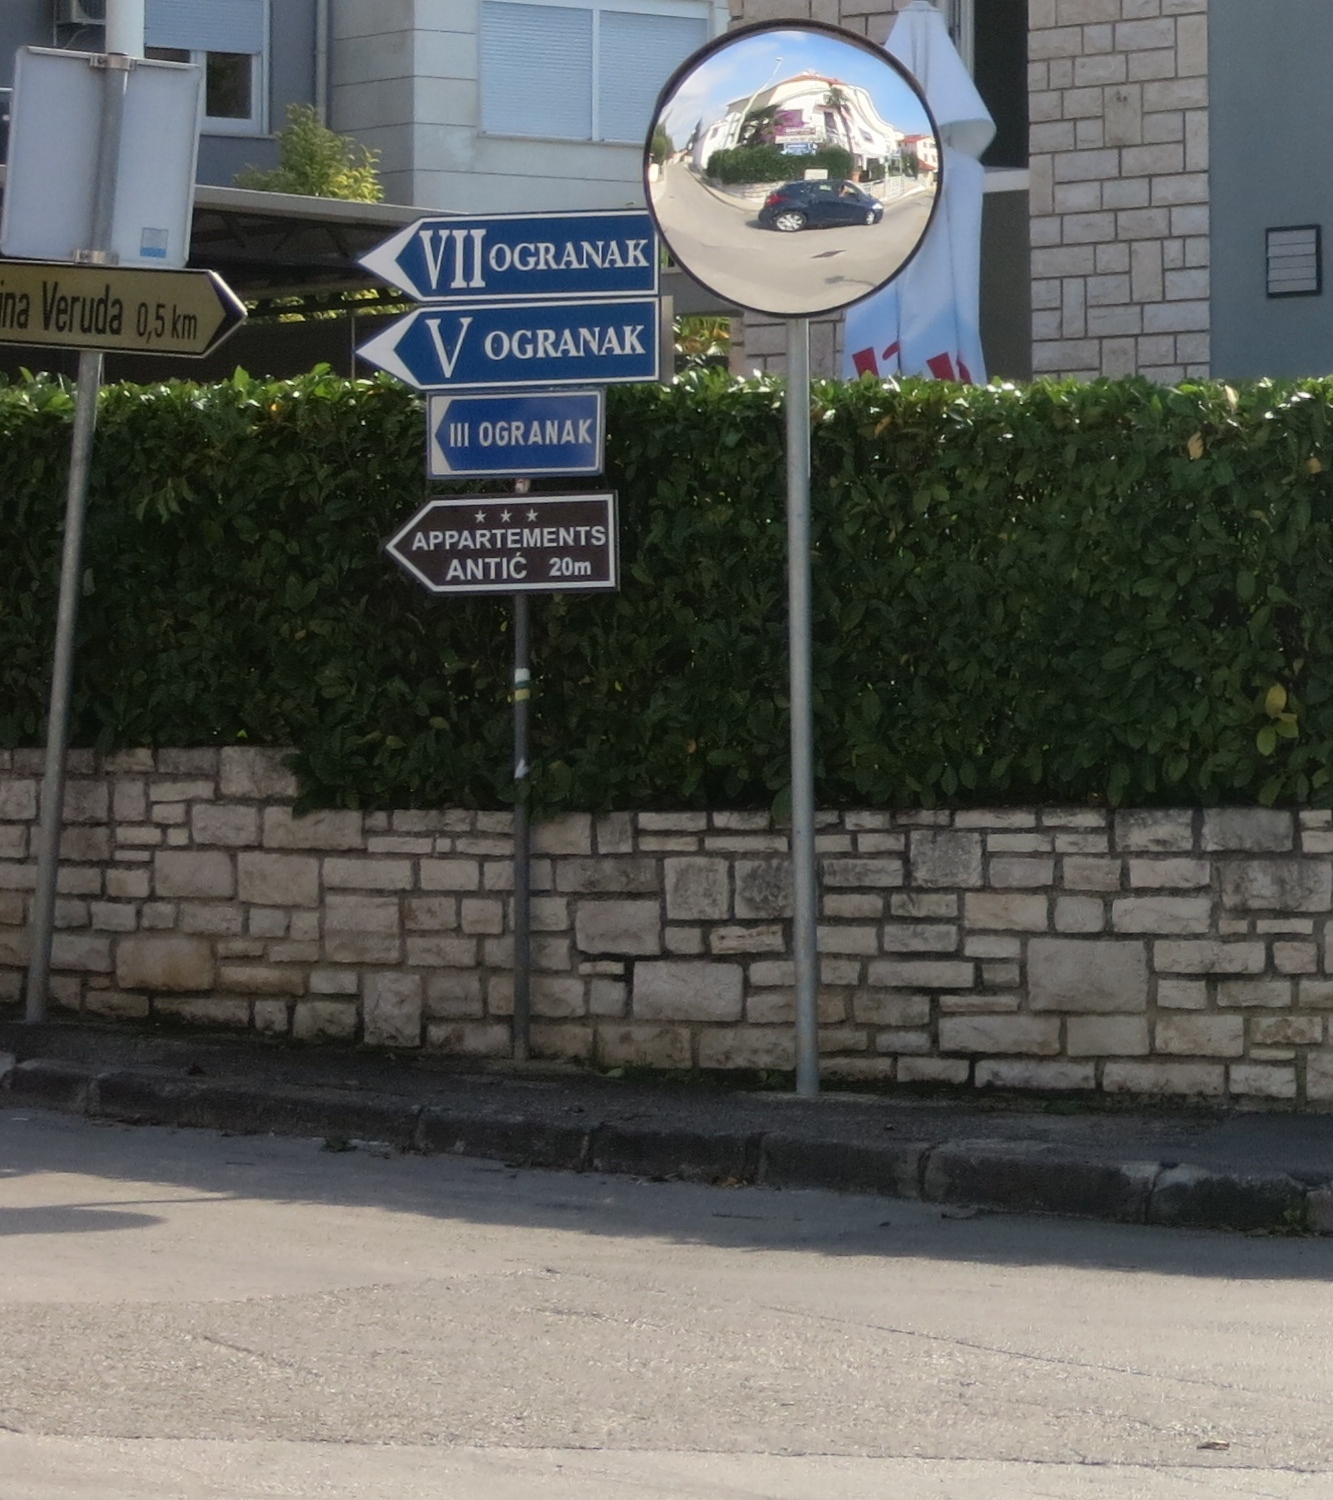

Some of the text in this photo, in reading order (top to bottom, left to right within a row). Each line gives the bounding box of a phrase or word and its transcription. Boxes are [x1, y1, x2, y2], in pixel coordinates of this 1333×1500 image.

[419, 228, 650, 290] VII OGRANAK
[42, 281, 124, 336] Veruda
[136, 302, 165, 344] 0,5
[171, 304, 198, 340] km
[425, 317, 646, 379] V OGRANAK
[450, 418, 593, 448] III OGRANAK
[411, 526, 607, 551] APPARTEMENTS
[445, 552, 592, 581] ANTIĆ 20m
